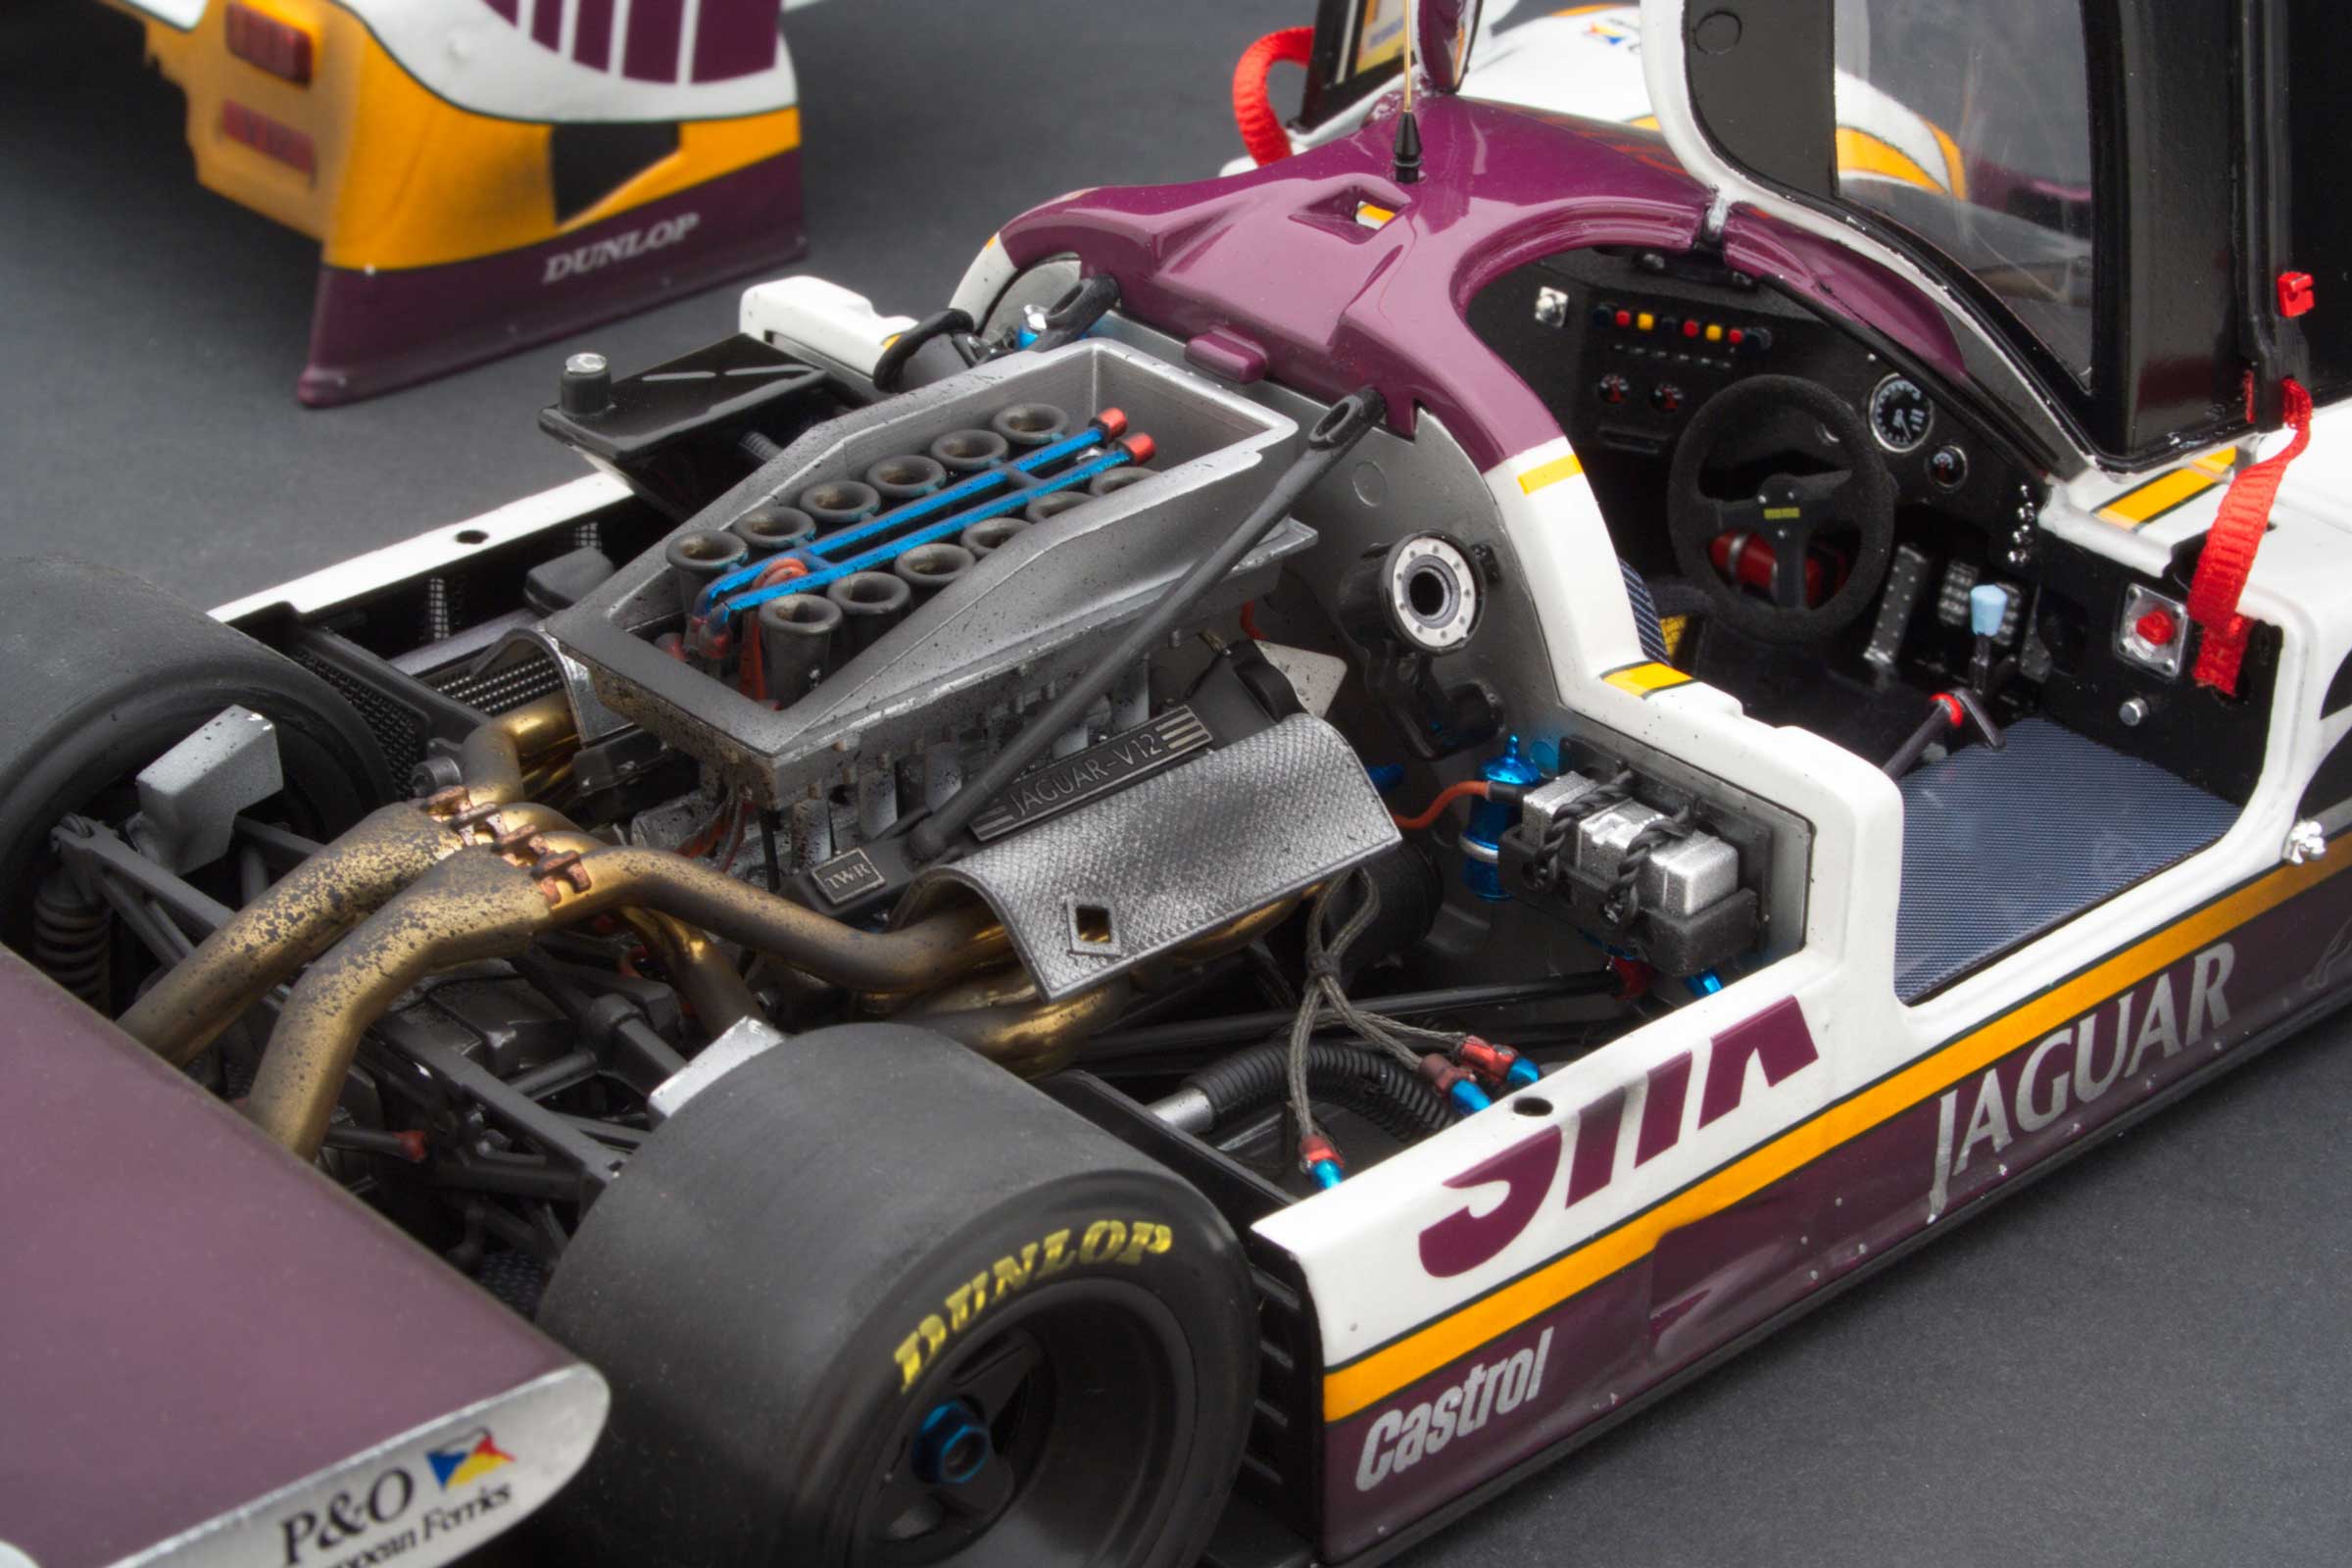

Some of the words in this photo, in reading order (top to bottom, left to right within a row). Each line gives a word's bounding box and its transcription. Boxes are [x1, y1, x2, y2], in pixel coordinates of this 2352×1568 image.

[542, 211, 701, 285] DUNLOP
[824, 862, 871, 889] TWR
[1927, 942, 2235, 1225] JAGUAR
[894, 1220, 1172, 1395] DUNLOP
[1355, 1327, 1554, 1492] Castrol
[280, 1466, 415, 1567] P&O
